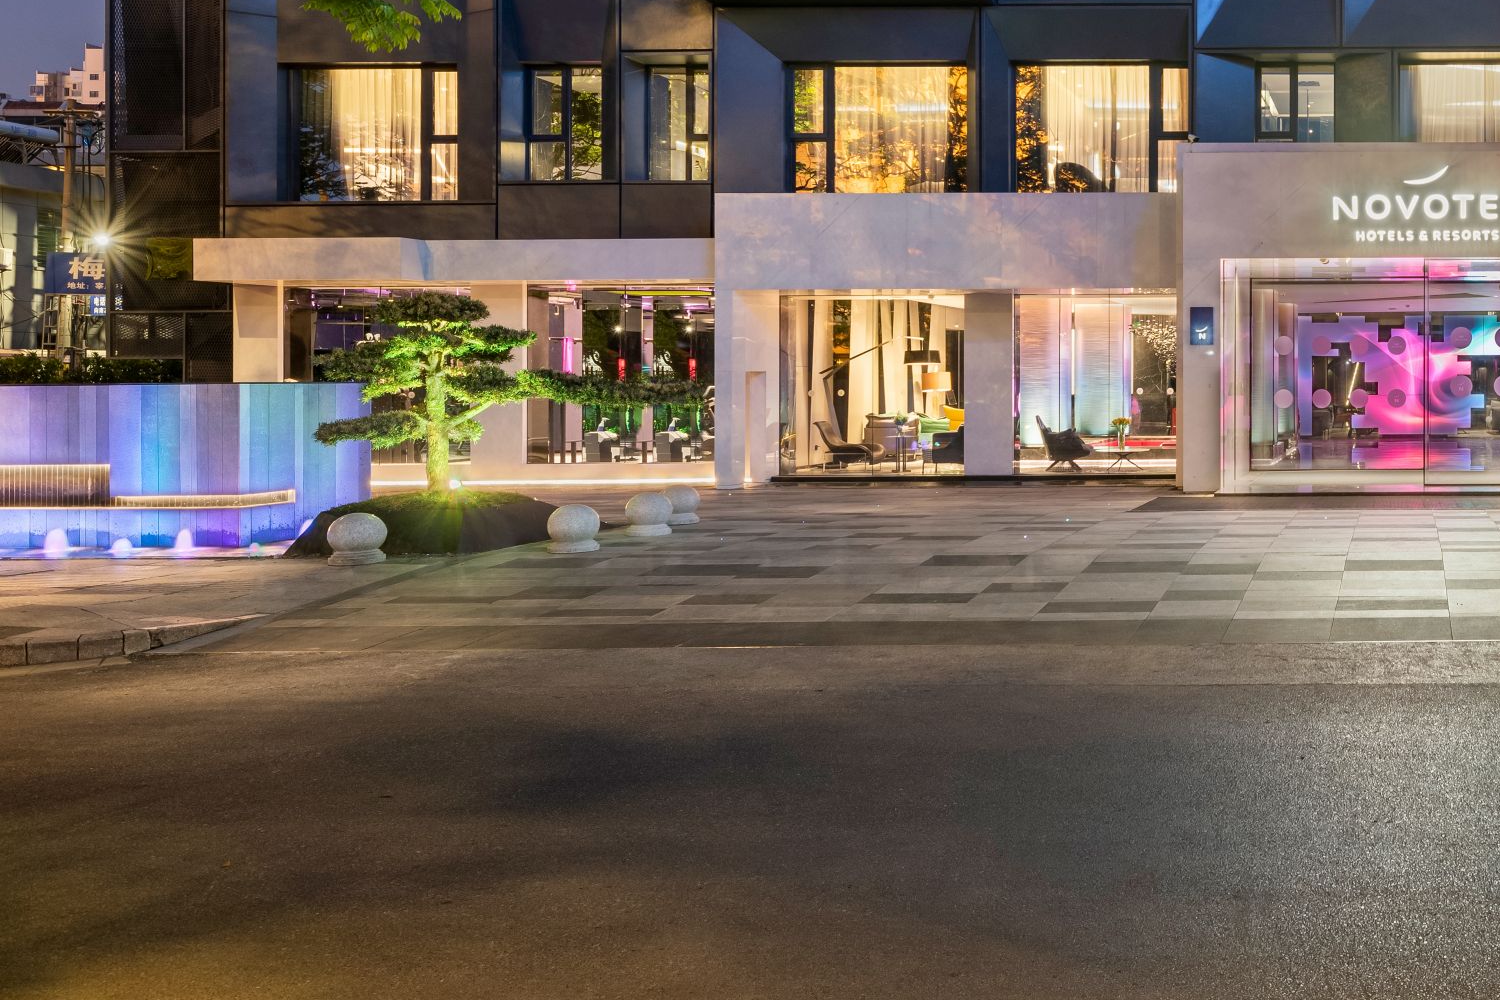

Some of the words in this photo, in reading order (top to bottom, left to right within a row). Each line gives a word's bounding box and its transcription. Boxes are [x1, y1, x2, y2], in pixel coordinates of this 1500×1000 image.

[1355, 229, 1414, 242] HOTELS
[1418, 230, 1428, 242] &
[1432, 229, 1500, 242] RESORTS
[1198, 332, 1206, 340] N
